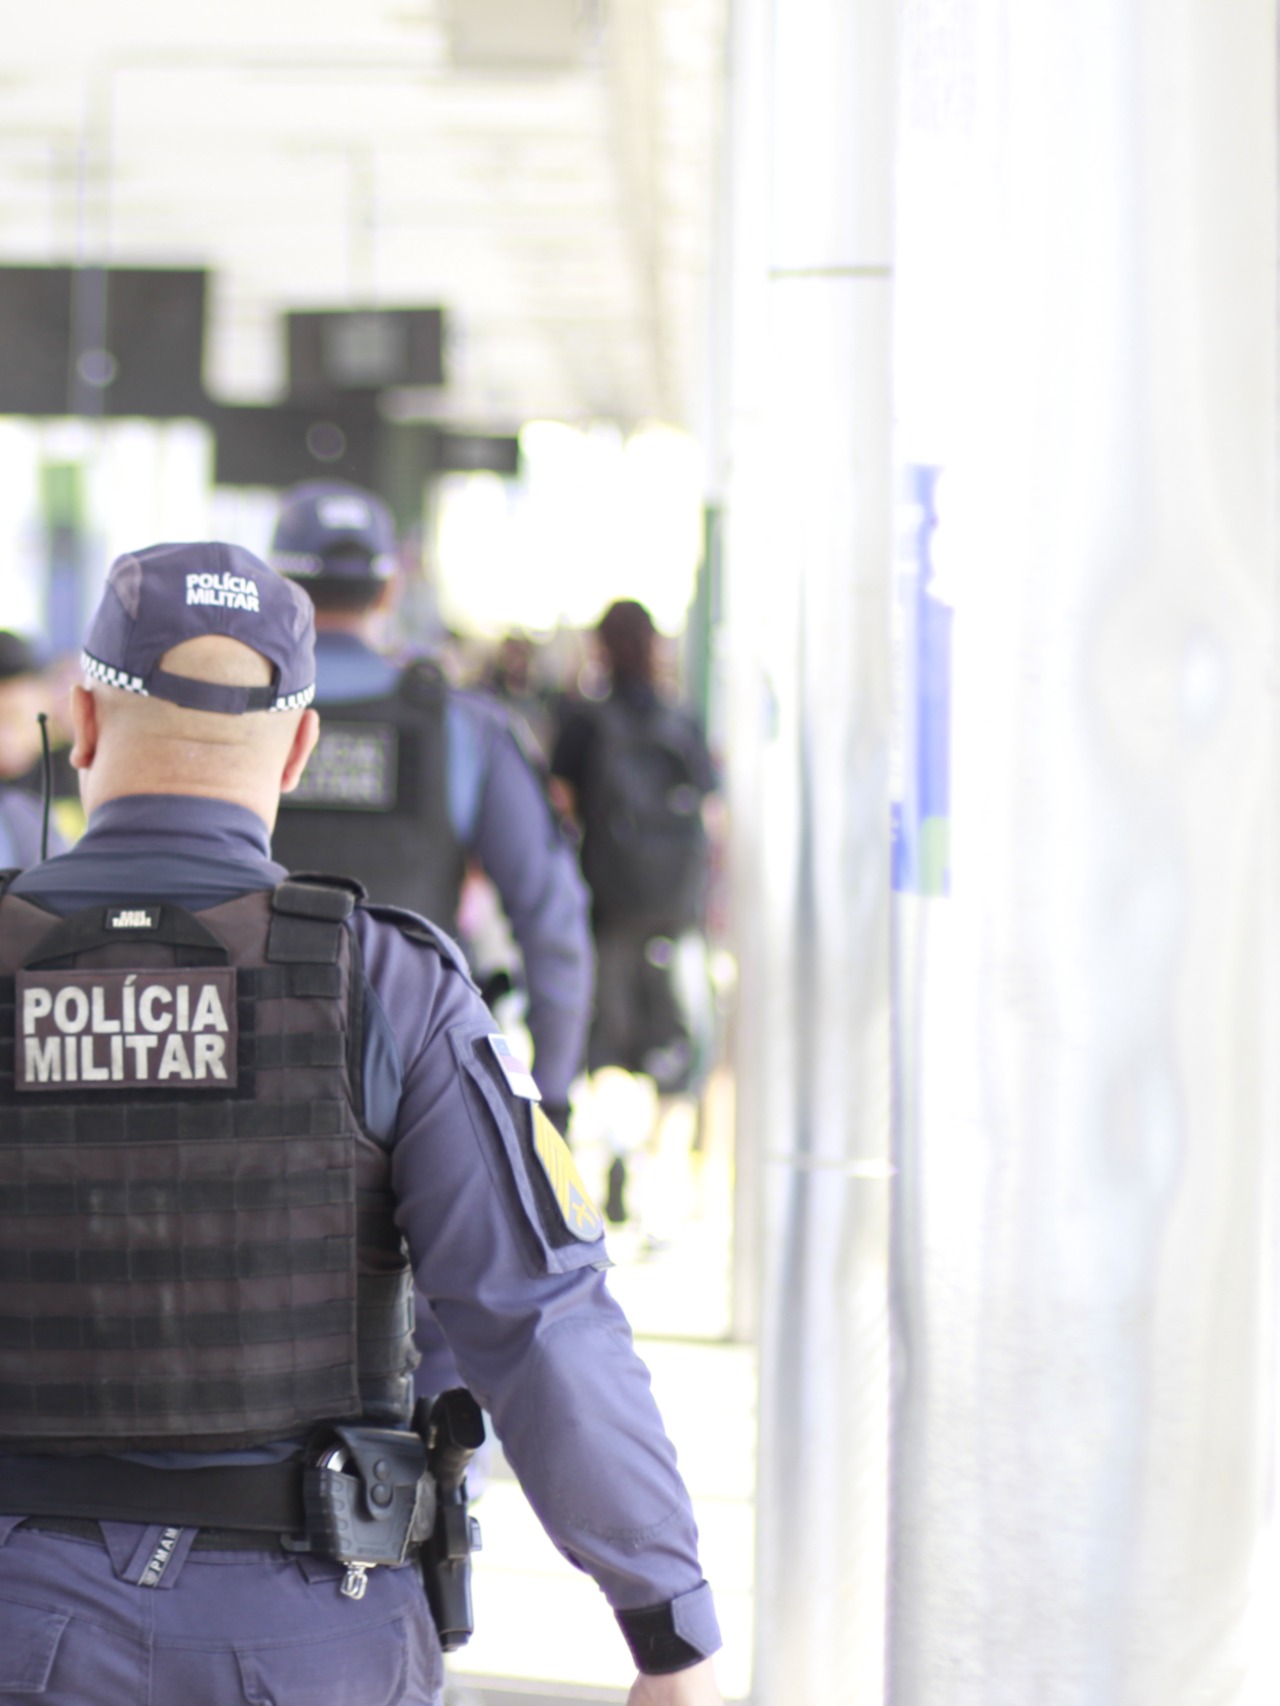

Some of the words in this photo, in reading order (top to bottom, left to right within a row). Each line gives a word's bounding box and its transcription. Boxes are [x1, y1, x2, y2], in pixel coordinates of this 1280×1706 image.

[186, 572, 259, 597] POLÍCIA
[186, 587, 260, 612] MILITAR
[23, 974, 229, 1035] POLÍCIA
[24, 1034, 228, 1082] MILITAR
